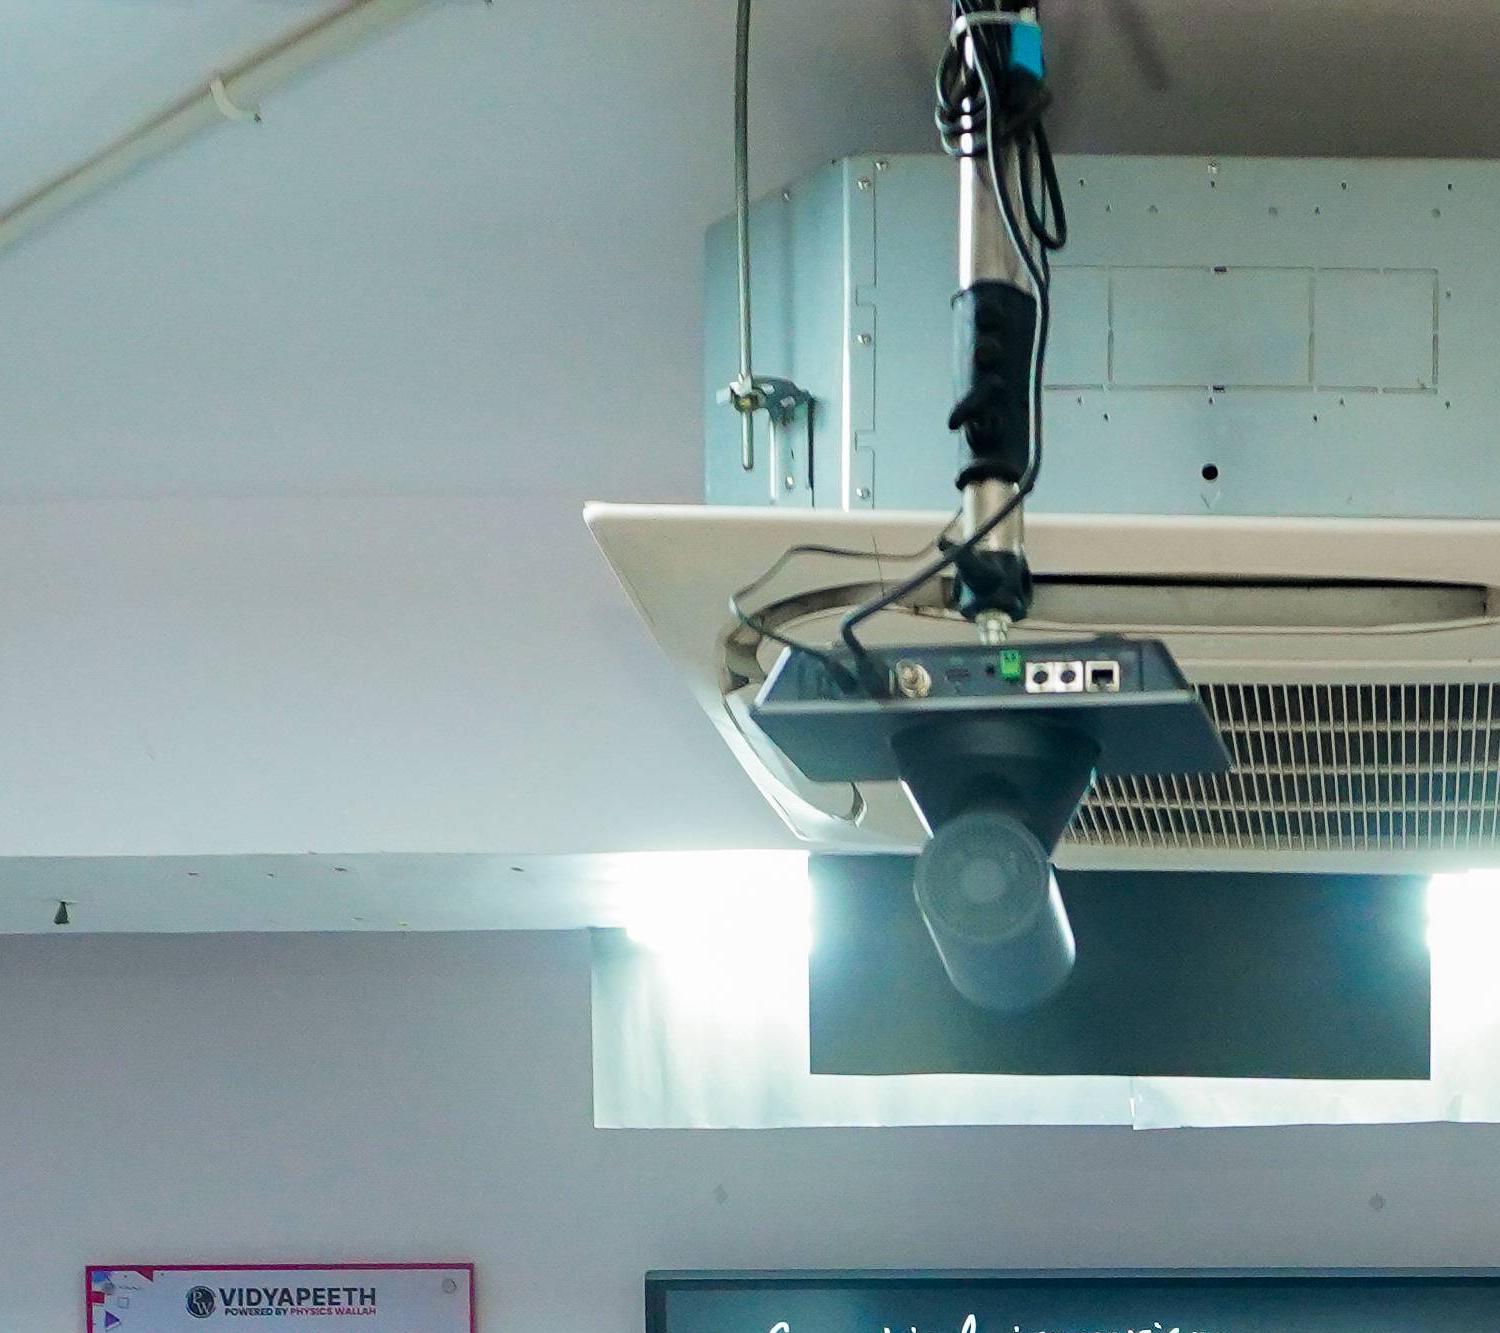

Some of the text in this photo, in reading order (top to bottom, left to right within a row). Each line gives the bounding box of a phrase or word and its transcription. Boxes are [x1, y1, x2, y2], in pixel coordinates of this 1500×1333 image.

[219, 1288, 376, 1306] VIDYAPEETH
[224, 1307, 377, 1316] POWERED BY PHYSICS WALLAH
